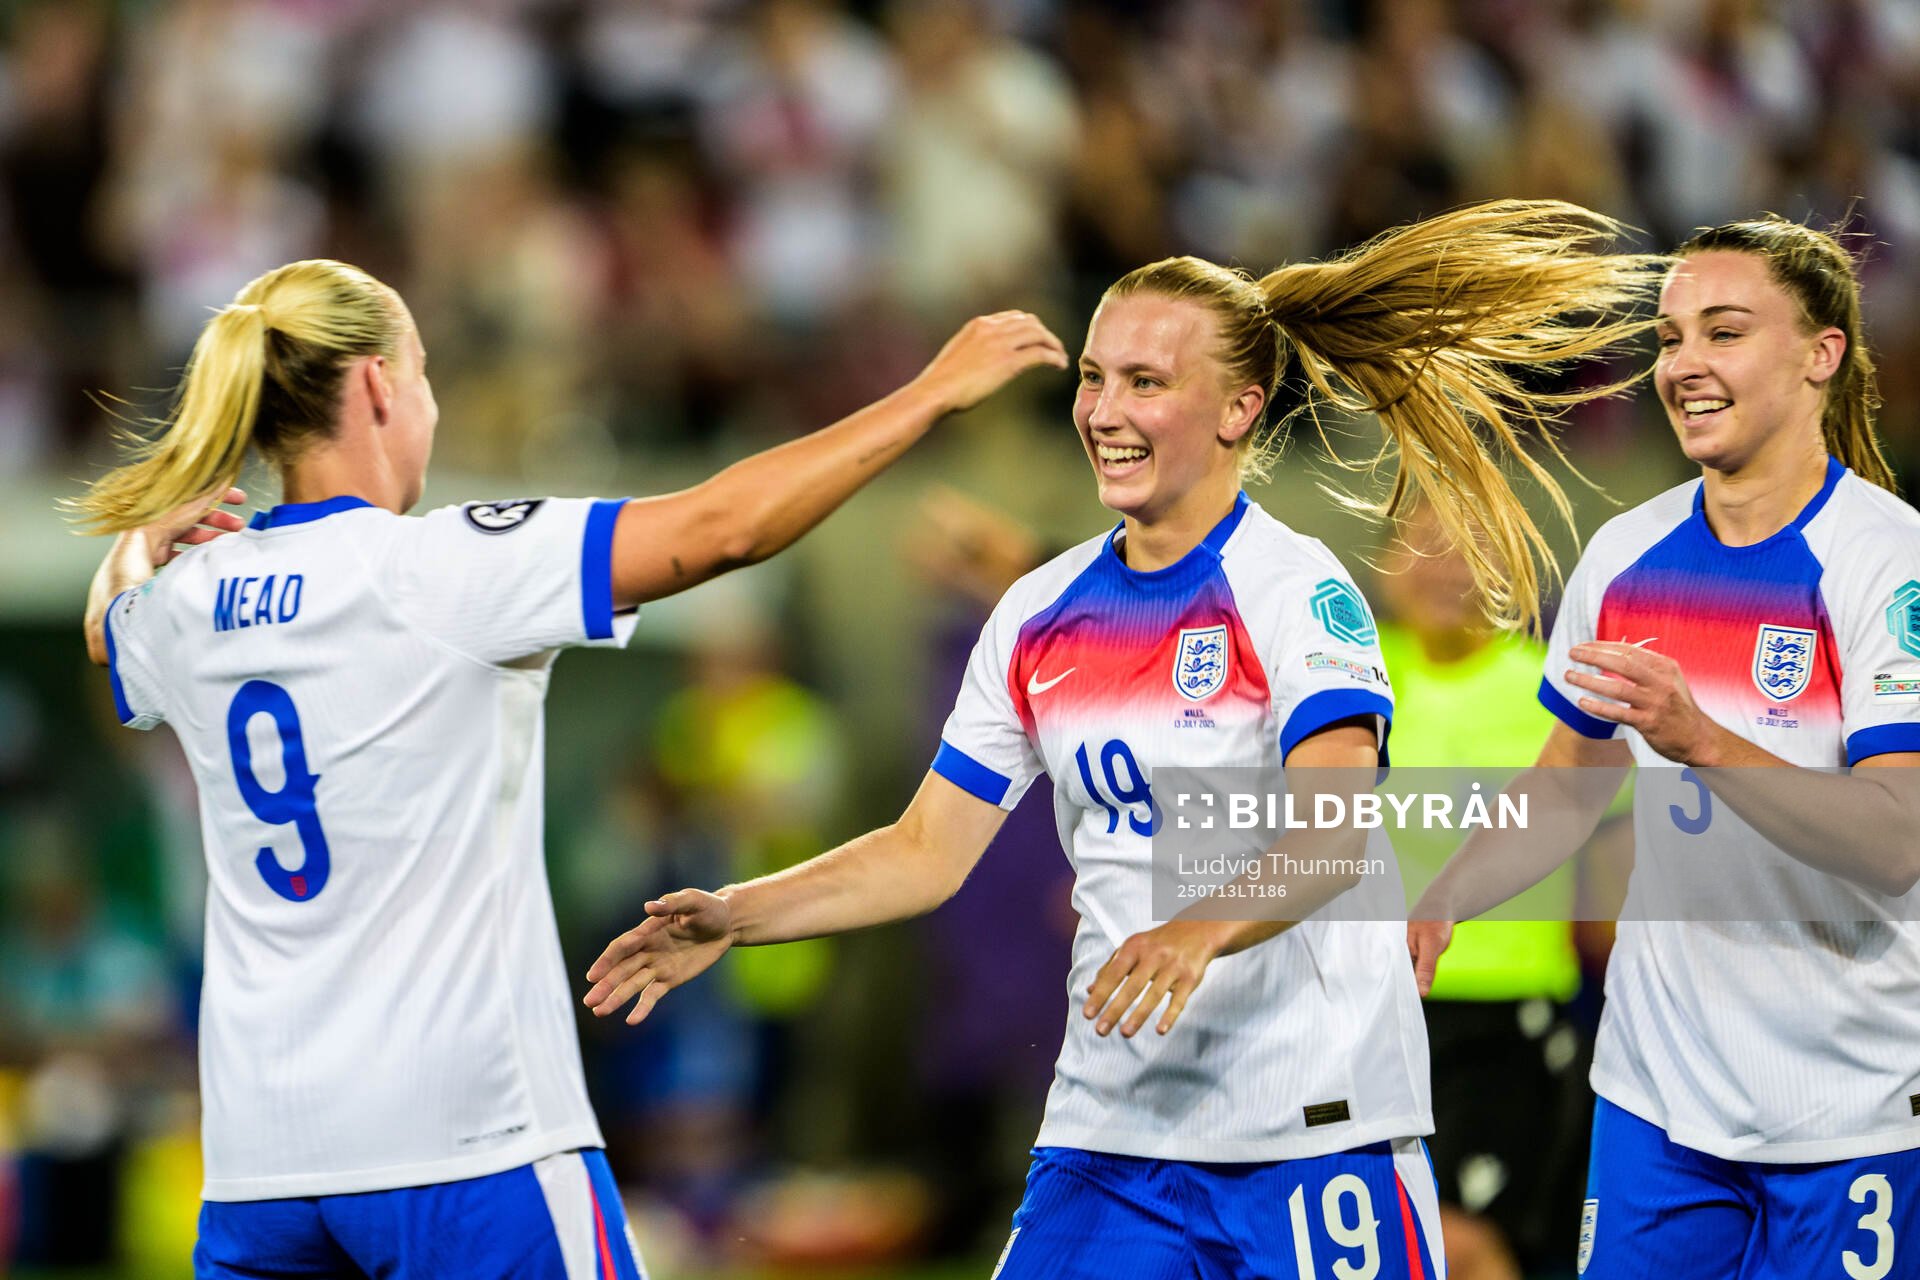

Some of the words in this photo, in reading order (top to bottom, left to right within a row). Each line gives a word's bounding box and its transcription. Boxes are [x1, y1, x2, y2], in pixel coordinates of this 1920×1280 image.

[214, 574, 304, 632] MEAD
[1184, 709, 1205, 718] WALES
[227, 680, 331, 903] 9
[1075, 739, 1163, 837] 19
[1288, 1173, 1380, 1280] 19
[1842, 1174, 1894, 1280] 3
